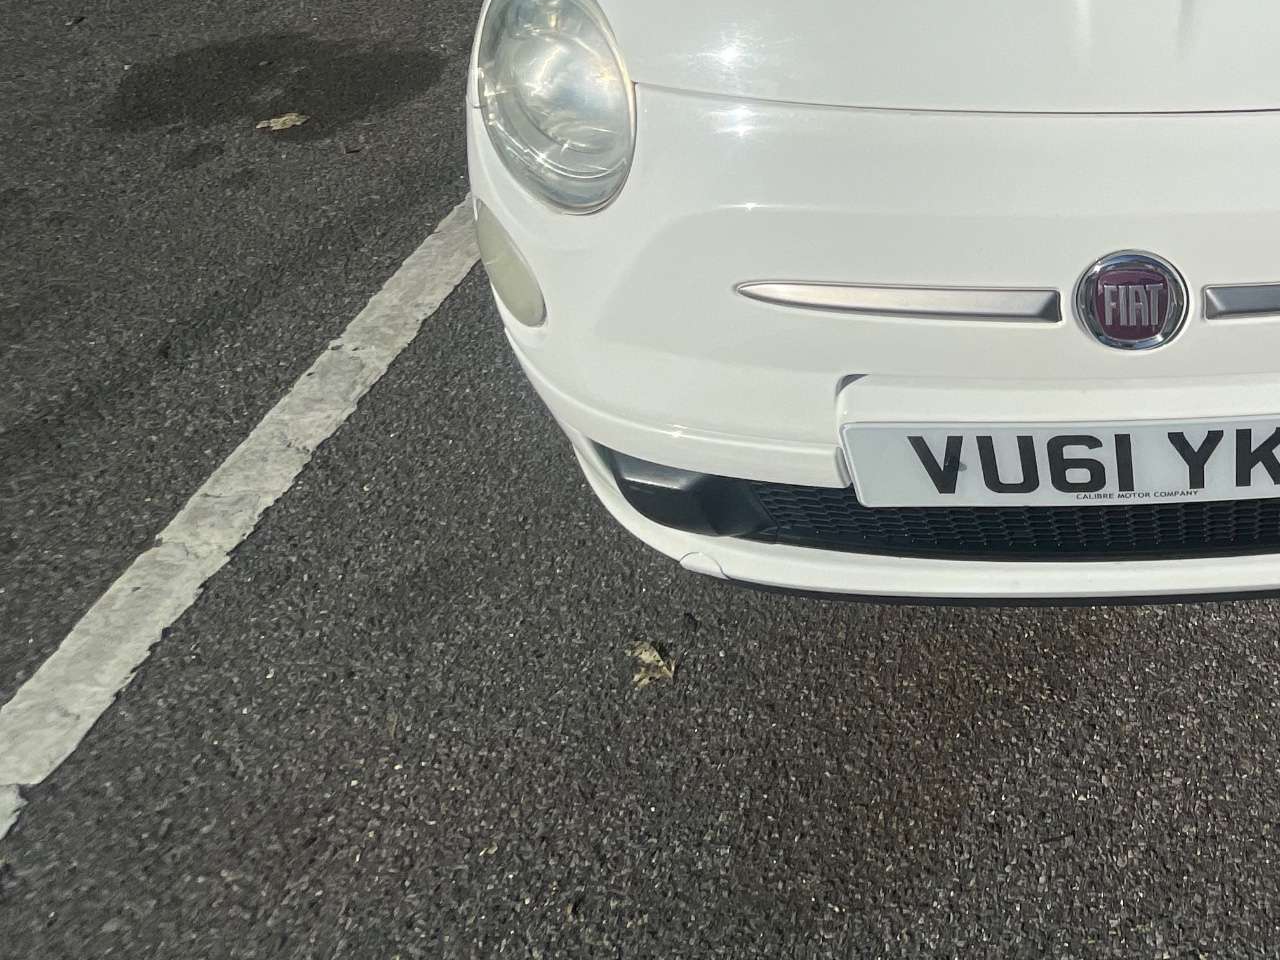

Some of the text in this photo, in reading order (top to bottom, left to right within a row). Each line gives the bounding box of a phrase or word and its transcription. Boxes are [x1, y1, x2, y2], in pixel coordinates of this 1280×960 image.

[1103, 283, 1163, 327] FIAT
[907, 433, 1135, 494] VU61
[1076, 489, 1199, 500] CALIBRE MOTOR COMPANY
